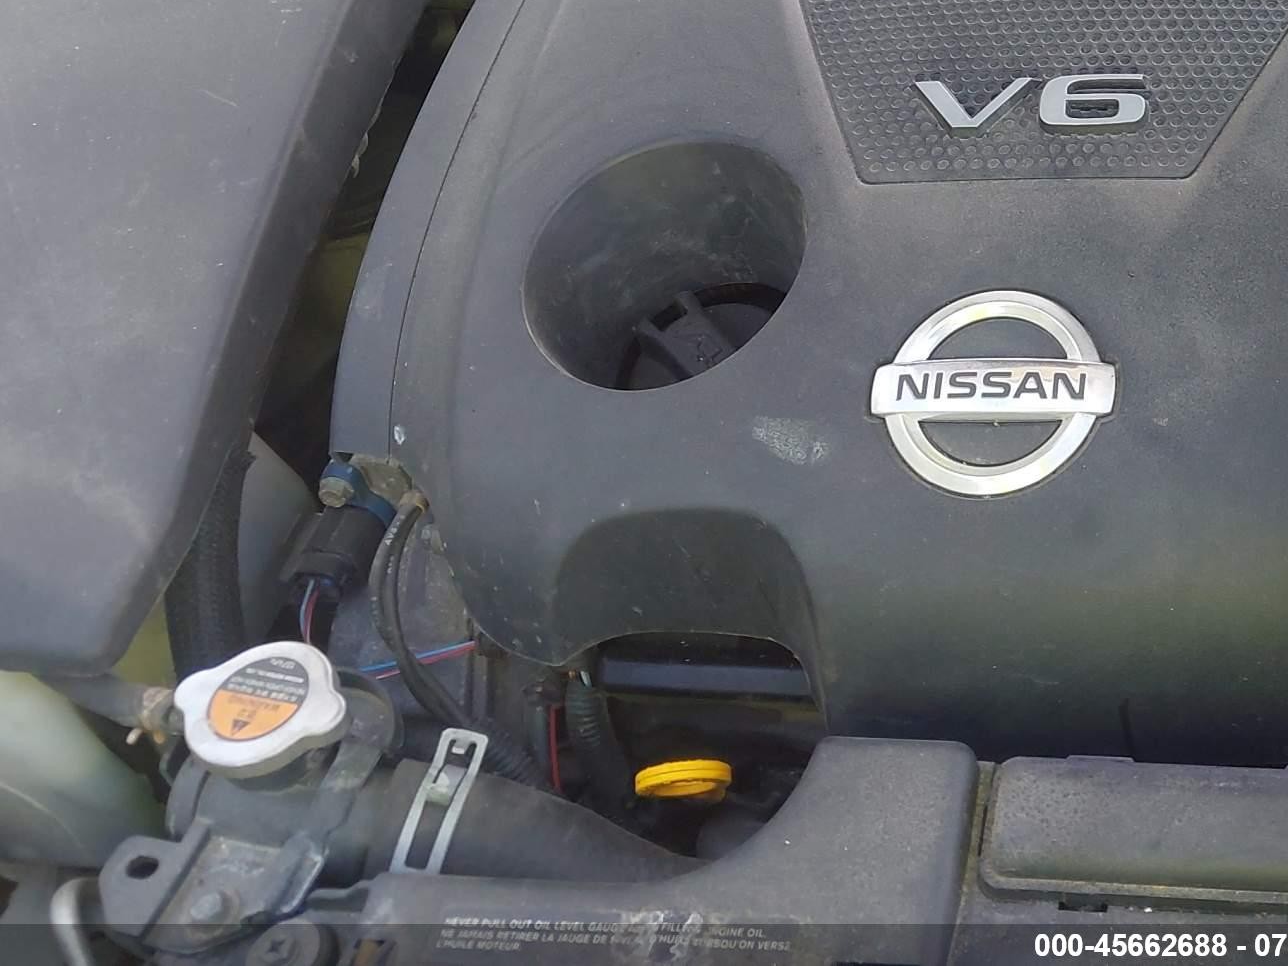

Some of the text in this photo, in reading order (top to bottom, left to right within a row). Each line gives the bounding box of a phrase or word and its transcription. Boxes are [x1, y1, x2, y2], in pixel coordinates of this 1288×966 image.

[915, 73, 1147, 132] V6
[896, 371, 1087, 401] NISSAN
[481, 918, 505, 929] PULL
[509, 919, 532, 929] OUT
[534, 921, 550, 930] OIL
[554, 921, 585, 932] LEVEL
[496, 931, 539, 942] RETIRER
[541, 933, 554, 942] LA
[557, 934, 588, 944] JAUGE
[592, 935, 606, 944] DE
